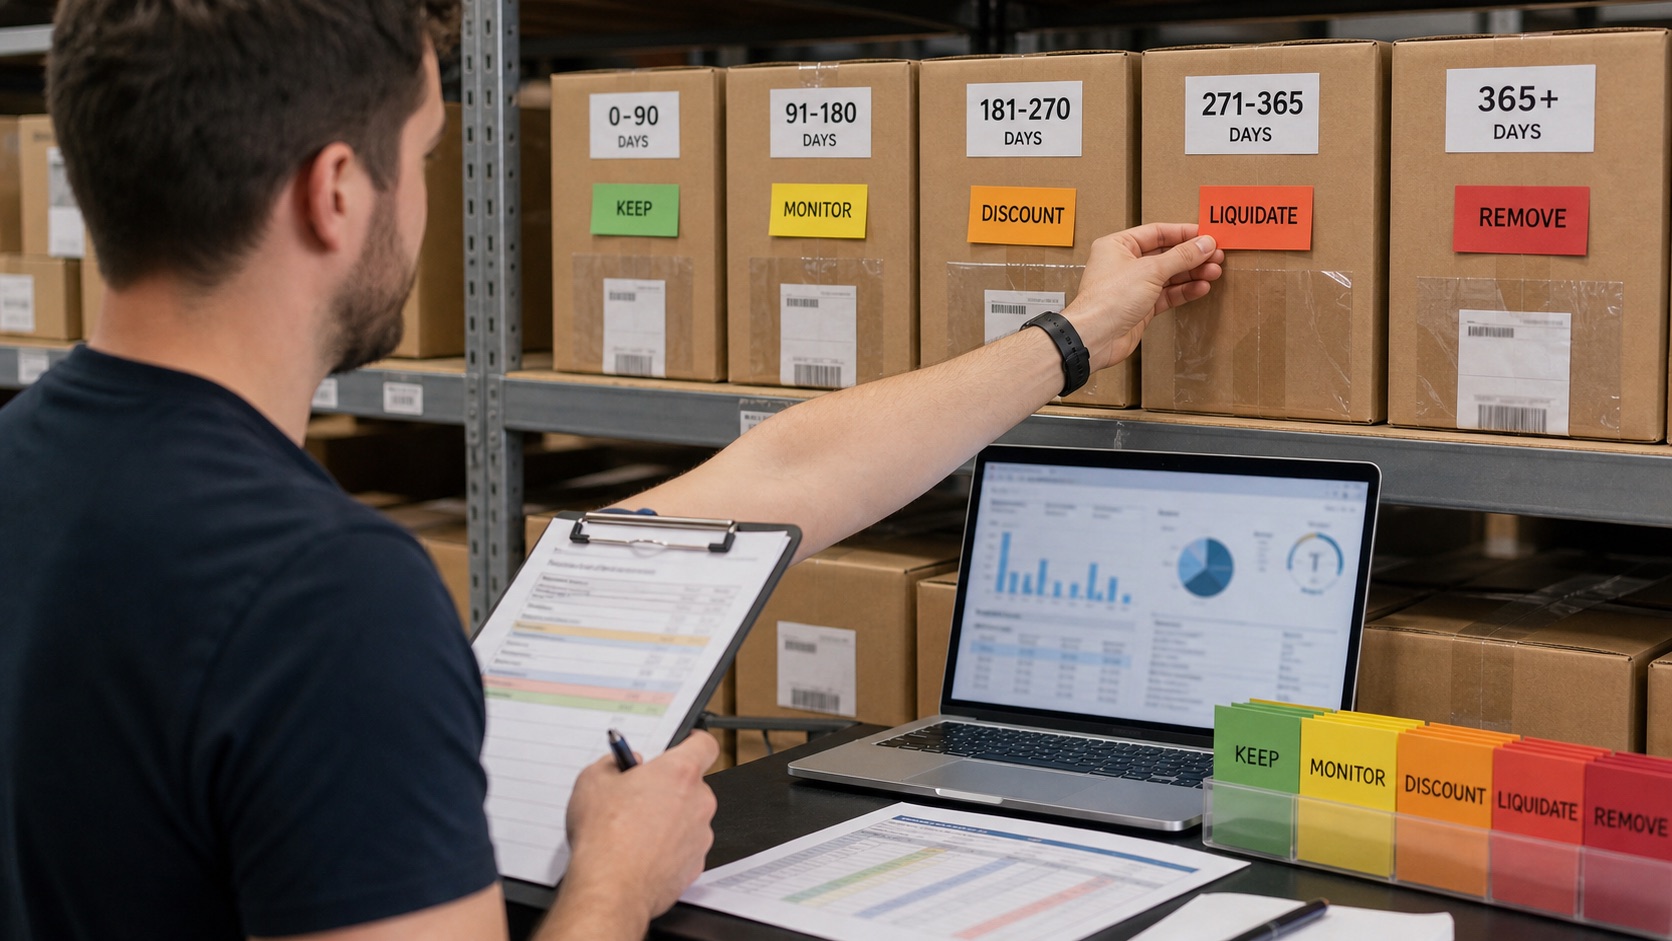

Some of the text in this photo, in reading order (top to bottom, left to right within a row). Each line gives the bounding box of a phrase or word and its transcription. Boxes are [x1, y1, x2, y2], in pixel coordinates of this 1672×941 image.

[980, 97, 1072, 122] 181-270
[1202, 90, 1304, 117] 271-365
[1478, 85, 1560, 113] 365+
[608, 105, 660, 126] 0-90
[785, 101, 858, 125] 91-180
[617, 134, 650, 148] DAYS
[802, 133, 837, 147] DAYS
[1004, 130, 1043, 146] DAYS
[1229, 126, 1273, 143] DAYS
[1493, 123, 1543, 141] DAYS
[616, 200, 653, 217] KEEP
[783, 200, 852, 218] MONITOR
[981, 203, 1065, 226] DISCOUNT
[1209, 205, 1299, 226] LIQUIDATE
[1478, 207, 1568, 229] REMOVE
[1235, 744, 1280, 769] KEEP
[1310, 757, 1387, 788] MONITOR
[1405, 774, 1488, 806] DISCOUNT
[1497, 790, 1579, 822] LIQUIDATE
[1594, 806, 1669, 838] REMOVE
